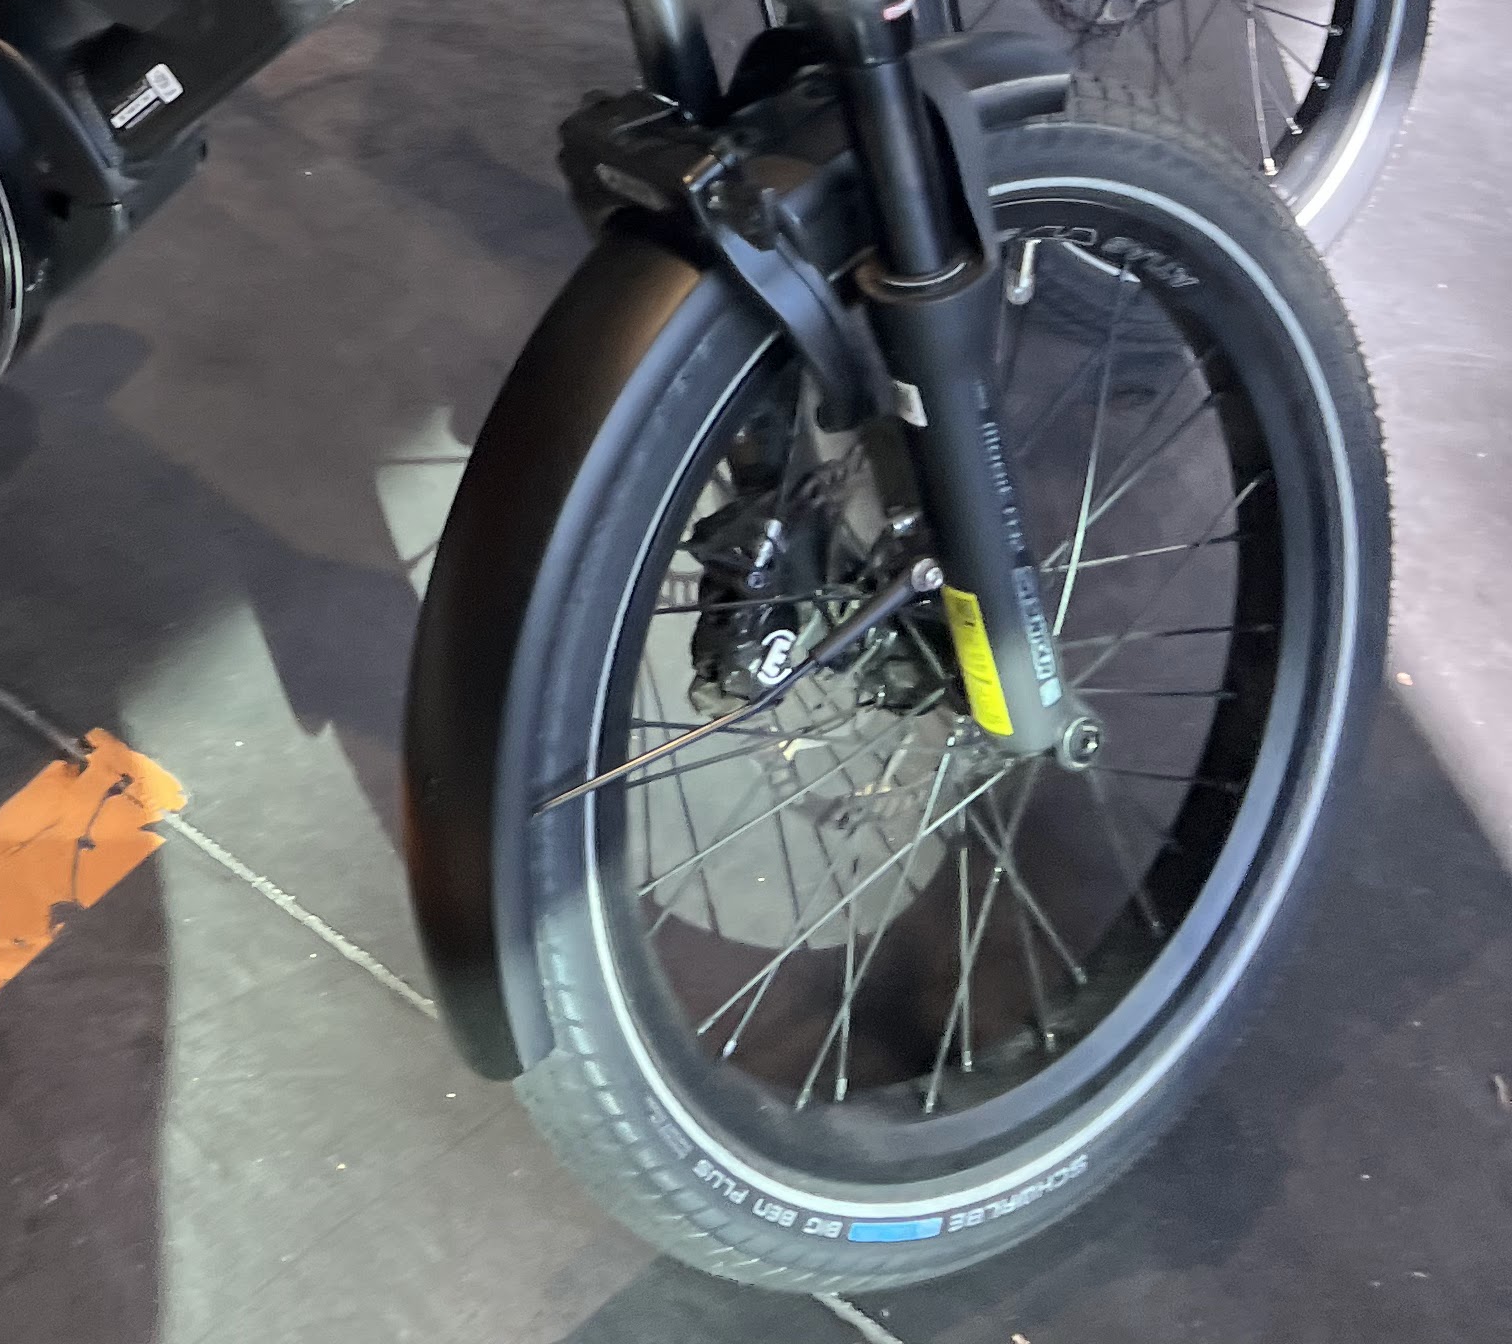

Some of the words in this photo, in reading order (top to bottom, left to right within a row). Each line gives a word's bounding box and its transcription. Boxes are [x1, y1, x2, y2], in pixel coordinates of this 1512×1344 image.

[693, 1157, 748, 1205] PLUS
[947, 1153, 1089, 1235] SCHWALBE
[803, 1215, 844, 1242] BIG
